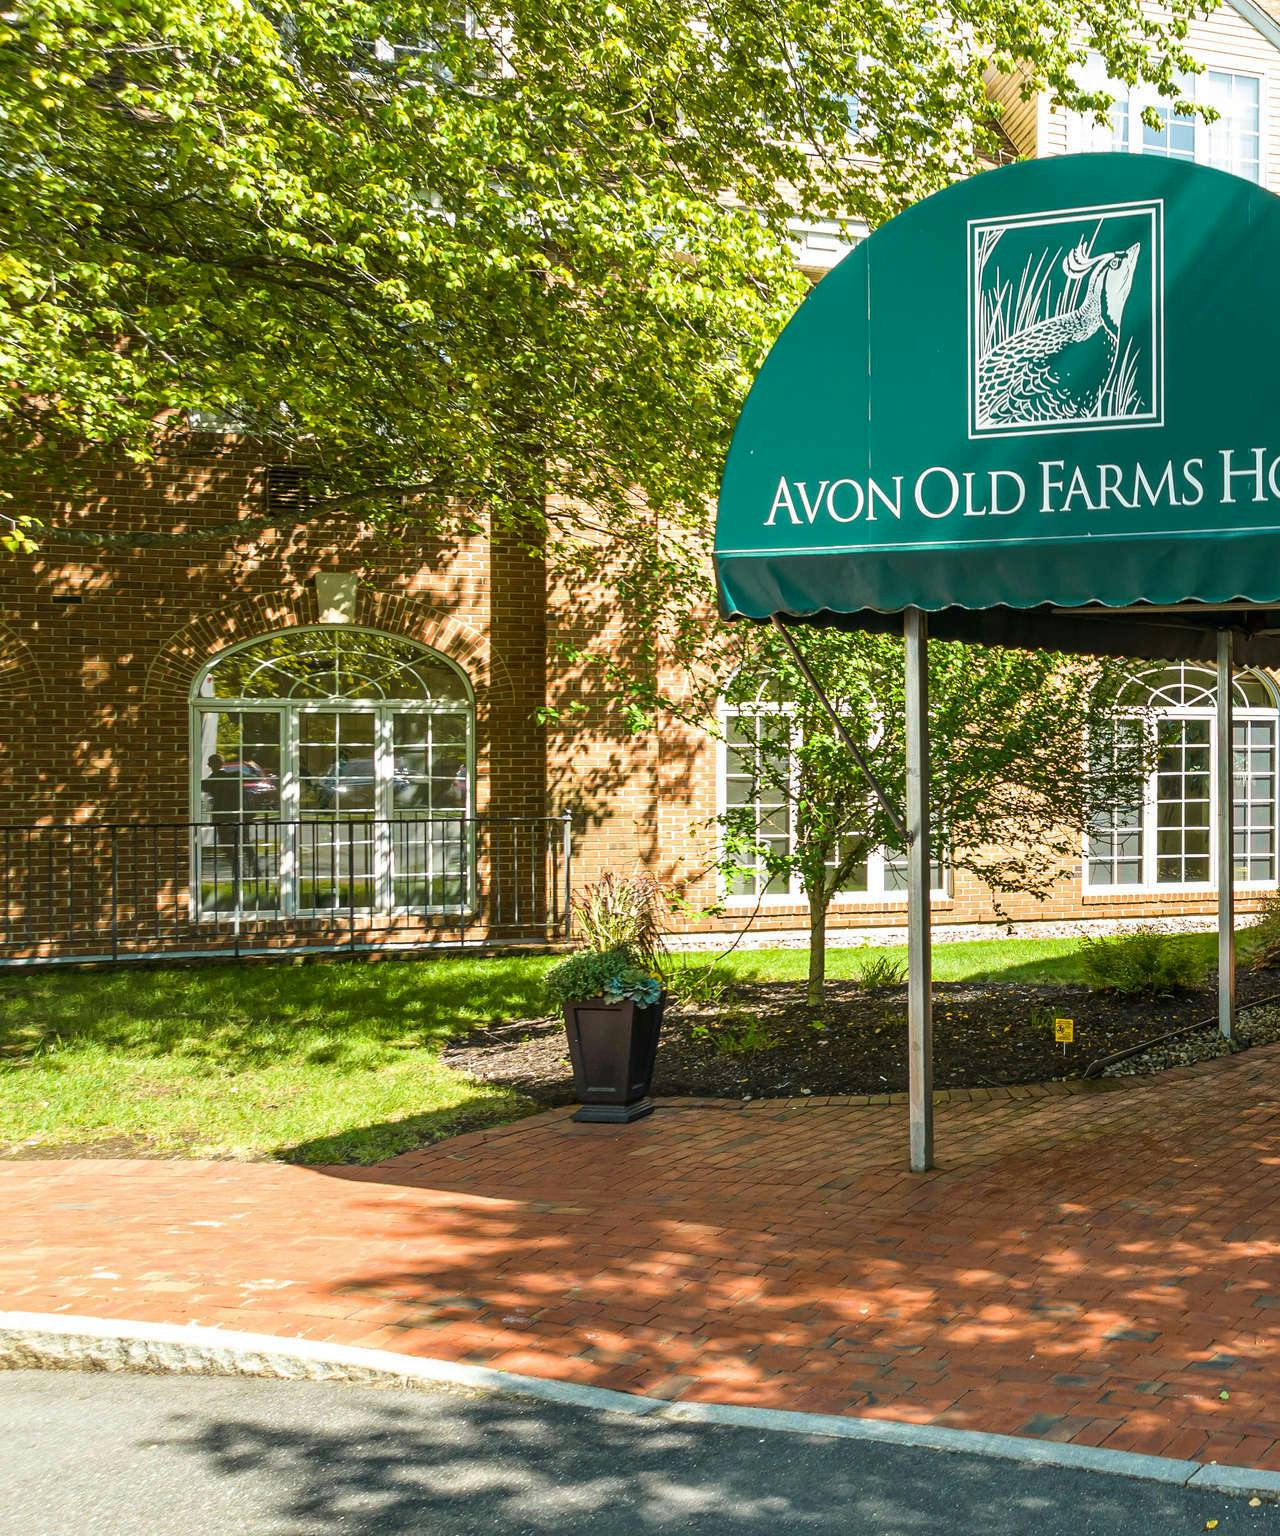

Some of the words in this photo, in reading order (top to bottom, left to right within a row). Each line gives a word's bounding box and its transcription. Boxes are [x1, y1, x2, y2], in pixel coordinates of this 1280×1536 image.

[763, 476, 904, 526] AVON
[914, 466, 1026, 519] OLD
[1038, 458, 1204, 513] FARMS
